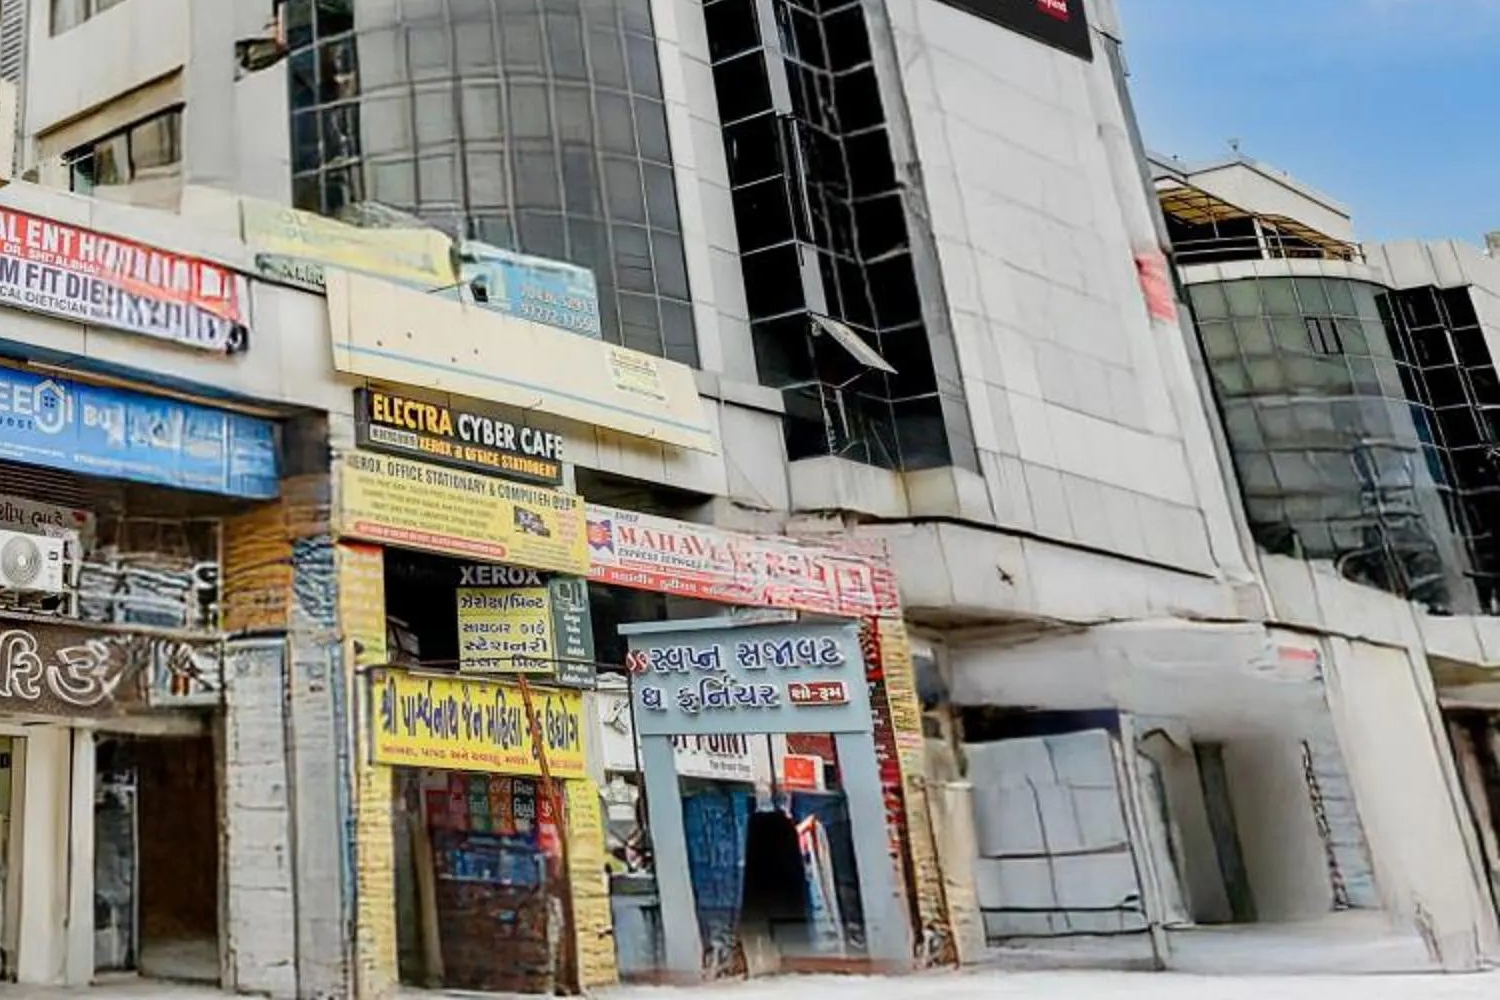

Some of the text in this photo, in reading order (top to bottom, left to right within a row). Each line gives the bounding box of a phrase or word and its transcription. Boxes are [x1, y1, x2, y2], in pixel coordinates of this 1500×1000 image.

[25, 218, 75, 258] ENT
[25, 262, 62, 294] FIT
[372, 393, 454, 437] ELECTRA
[457, 413, 516, 451] CYBER
[520, 427, 563, 461] CAFE
[387, 461, 423, 482] OFFICE
[465, 447, 499, 467] OFFICE
[459, 565, 542, 586] XEROX
[736, 637, 845, 670] સજાવટ
